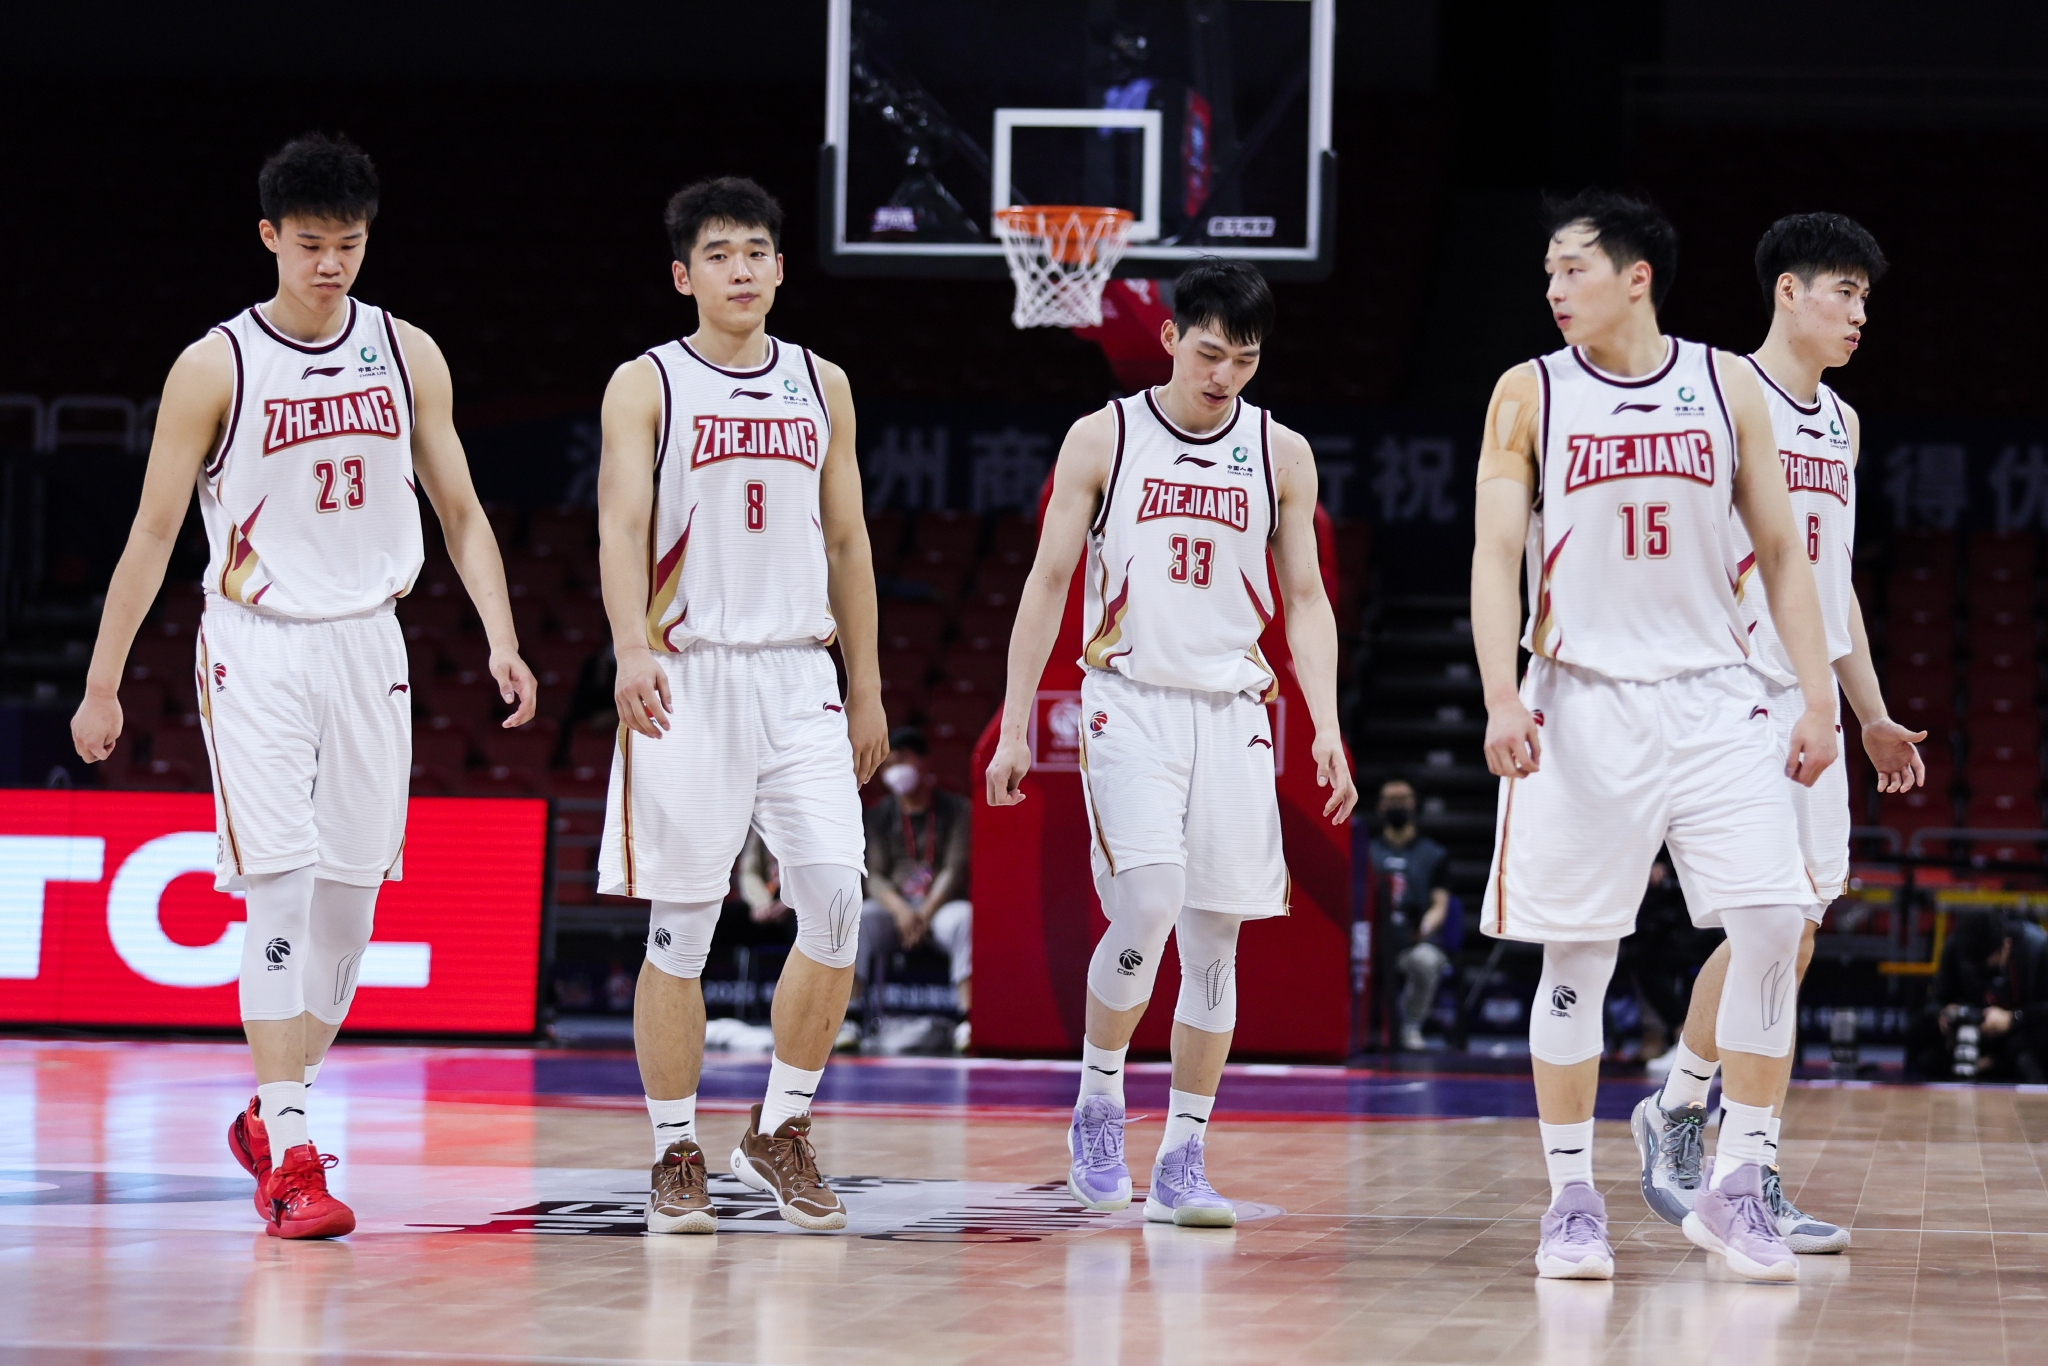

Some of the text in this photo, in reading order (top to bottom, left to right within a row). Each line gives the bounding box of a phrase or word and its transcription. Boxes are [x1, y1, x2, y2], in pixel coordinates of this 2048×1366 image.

[267, 388, 398, 451] ZHEJIANG
[692, 417, 817, 469] ZHEJIANG
[314, 457, 365, 512] 23
[1567, 431, 1714, 488] ZHEJIANG
[745, 480, 766, 533] 8
[1139, 481, 1248, 531] ZHEJIANG
[1618, 502, 1671, 560] 15
[1168, 534, 1214, 588] 33
[1806, 512, 1821, 564] 6
[1116, 967, 1136, 977] CBA
